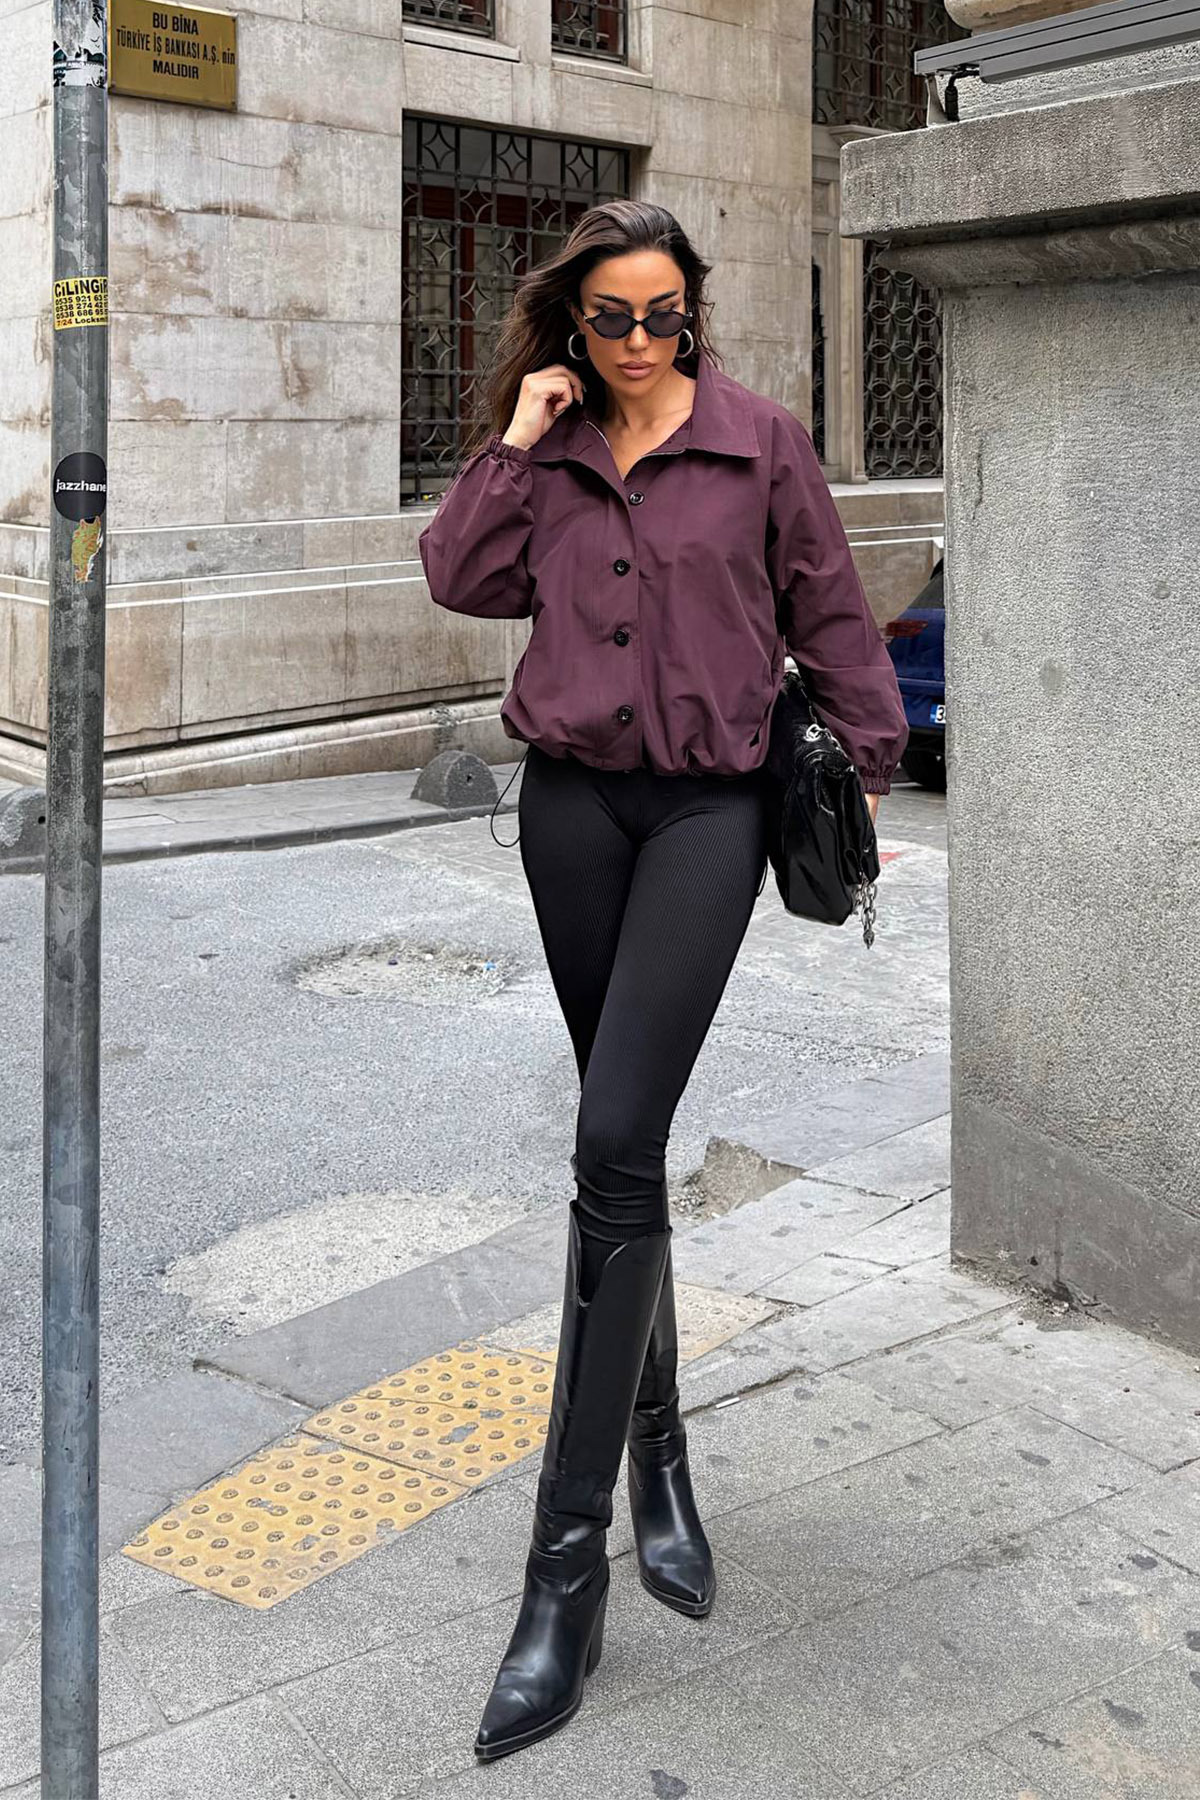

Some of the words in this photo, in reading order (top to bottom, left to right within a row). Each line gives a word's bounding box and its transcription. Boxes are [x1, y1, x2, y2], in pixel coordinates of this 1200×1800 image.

[152, 12, 169, 30] BU
[172, 14, 199, 35] BİNA
[116, 25, 151, 51] TÜRKİYE
[153, 32, 162, 56] İŞ
[165, 37, 200, 59] BANKASI
[152, 59, 200, 79] MALIDIR
[75, 295, 91, 303] 921
[76, 302, 93, 310] 274
[937, 706, 946, 721] 3
